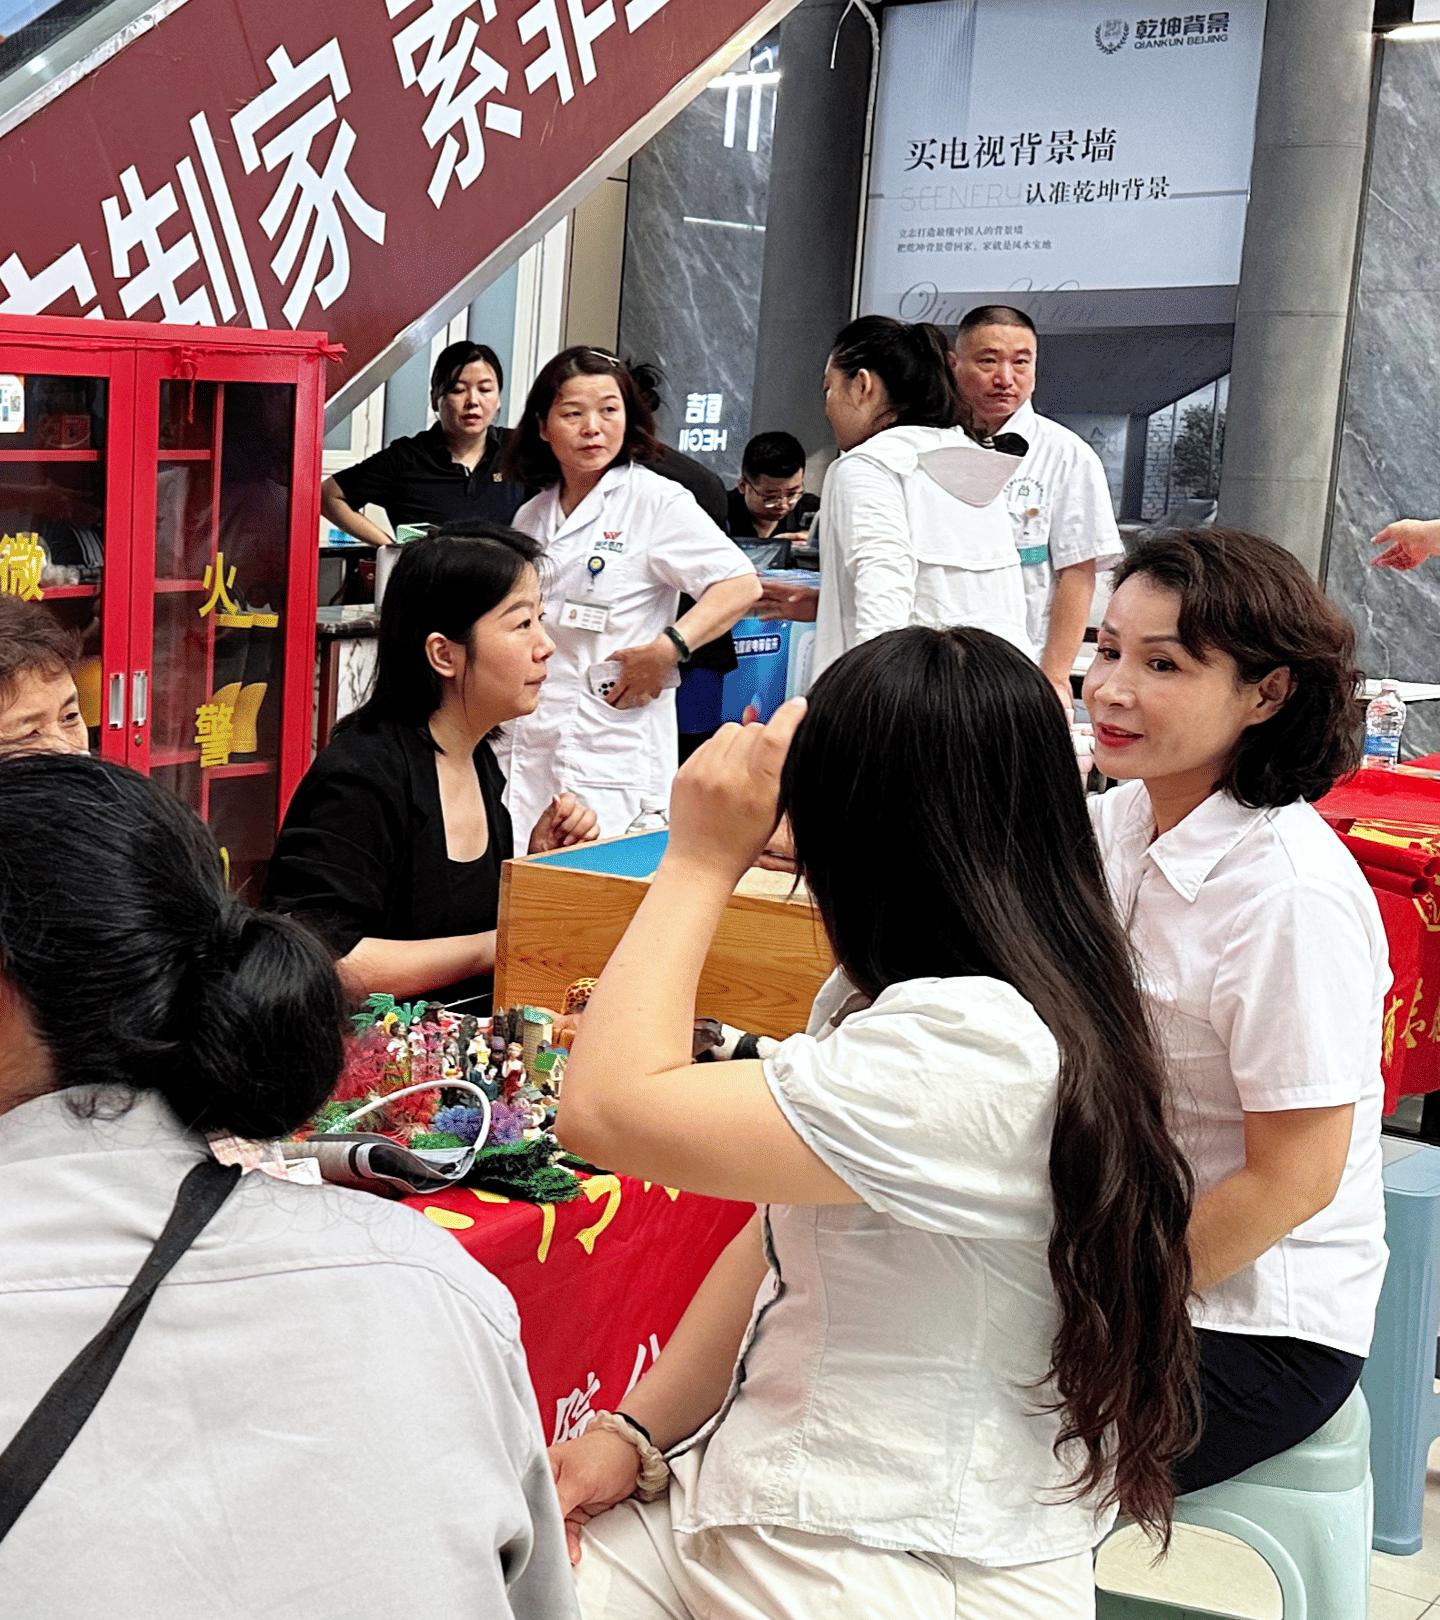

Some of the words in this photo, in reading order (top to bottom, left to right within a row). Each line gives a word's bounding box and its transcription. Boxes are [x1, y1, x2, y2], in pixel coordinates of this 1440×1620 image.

[1135, 12, 1229, 39] 乾坤背景
[1135, 37, 1184, 49] QIANKUN
[1186, 33, 1228, 45] BEIJING
[904, 127, 1117, 172] 买电视背景墙
[1026, 176, 1170, 205] 认准乾坤背景
